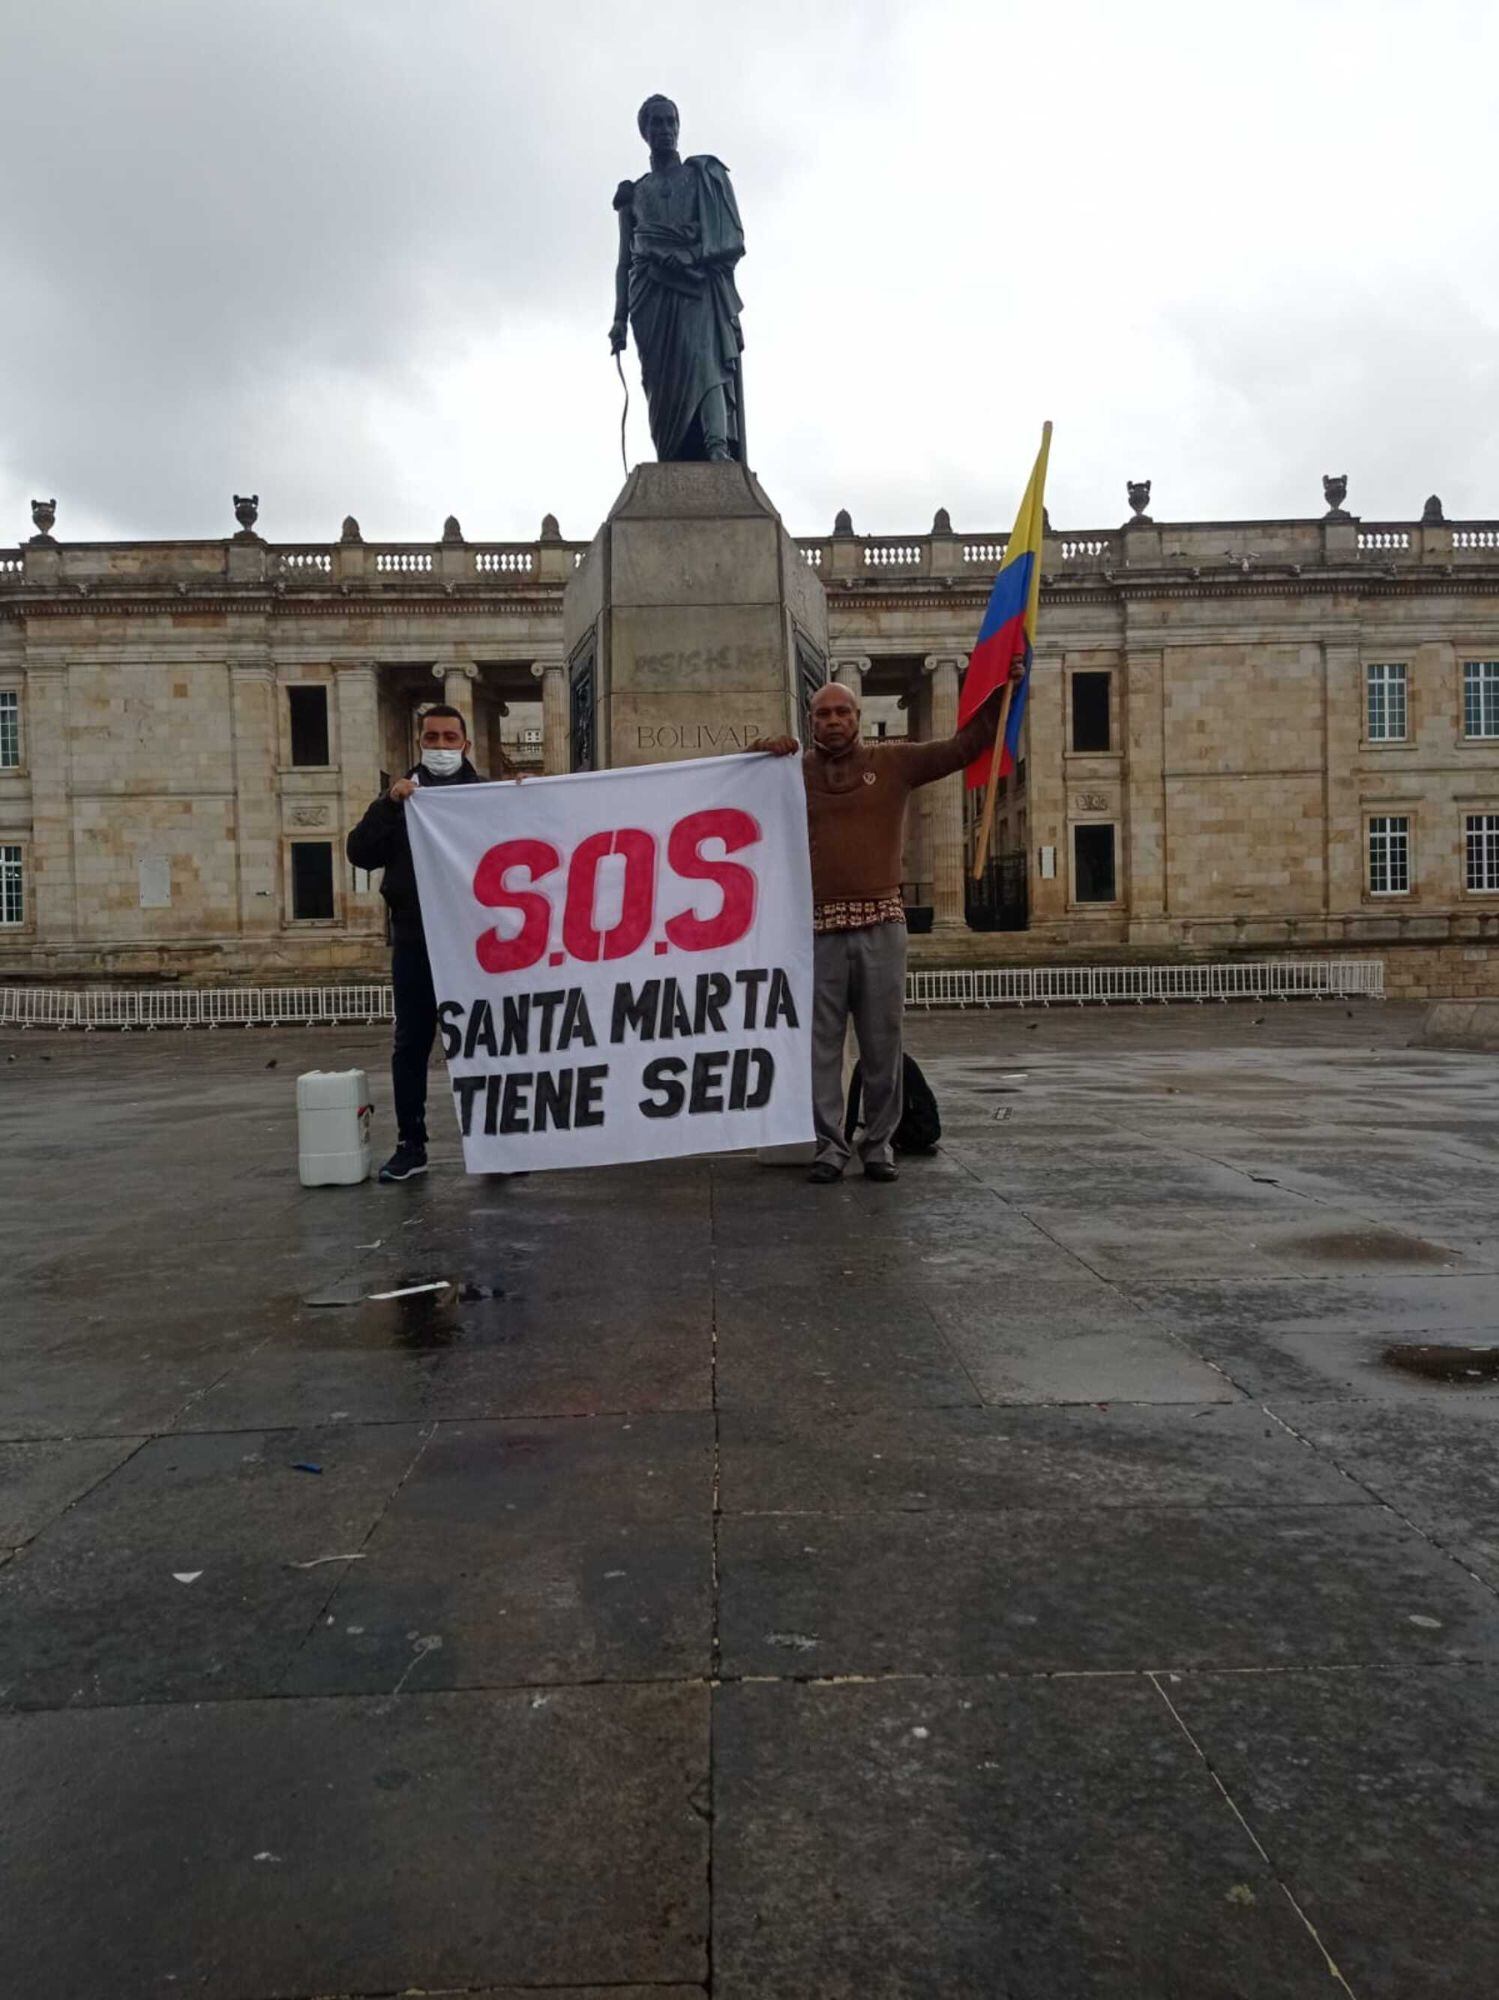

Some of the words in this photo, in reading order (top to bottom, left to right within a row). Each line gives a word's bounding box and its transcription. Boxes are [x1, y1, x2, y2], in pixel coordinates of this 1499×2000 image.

[473, 808, 763, 974] S.O.S
[438, 987, 597, 1060] SANTA
[610, 967, 799, 1044] MARTA
[453, 1064, 608, 1136] TIENE
[638, 1048, 775, 1119] SED
